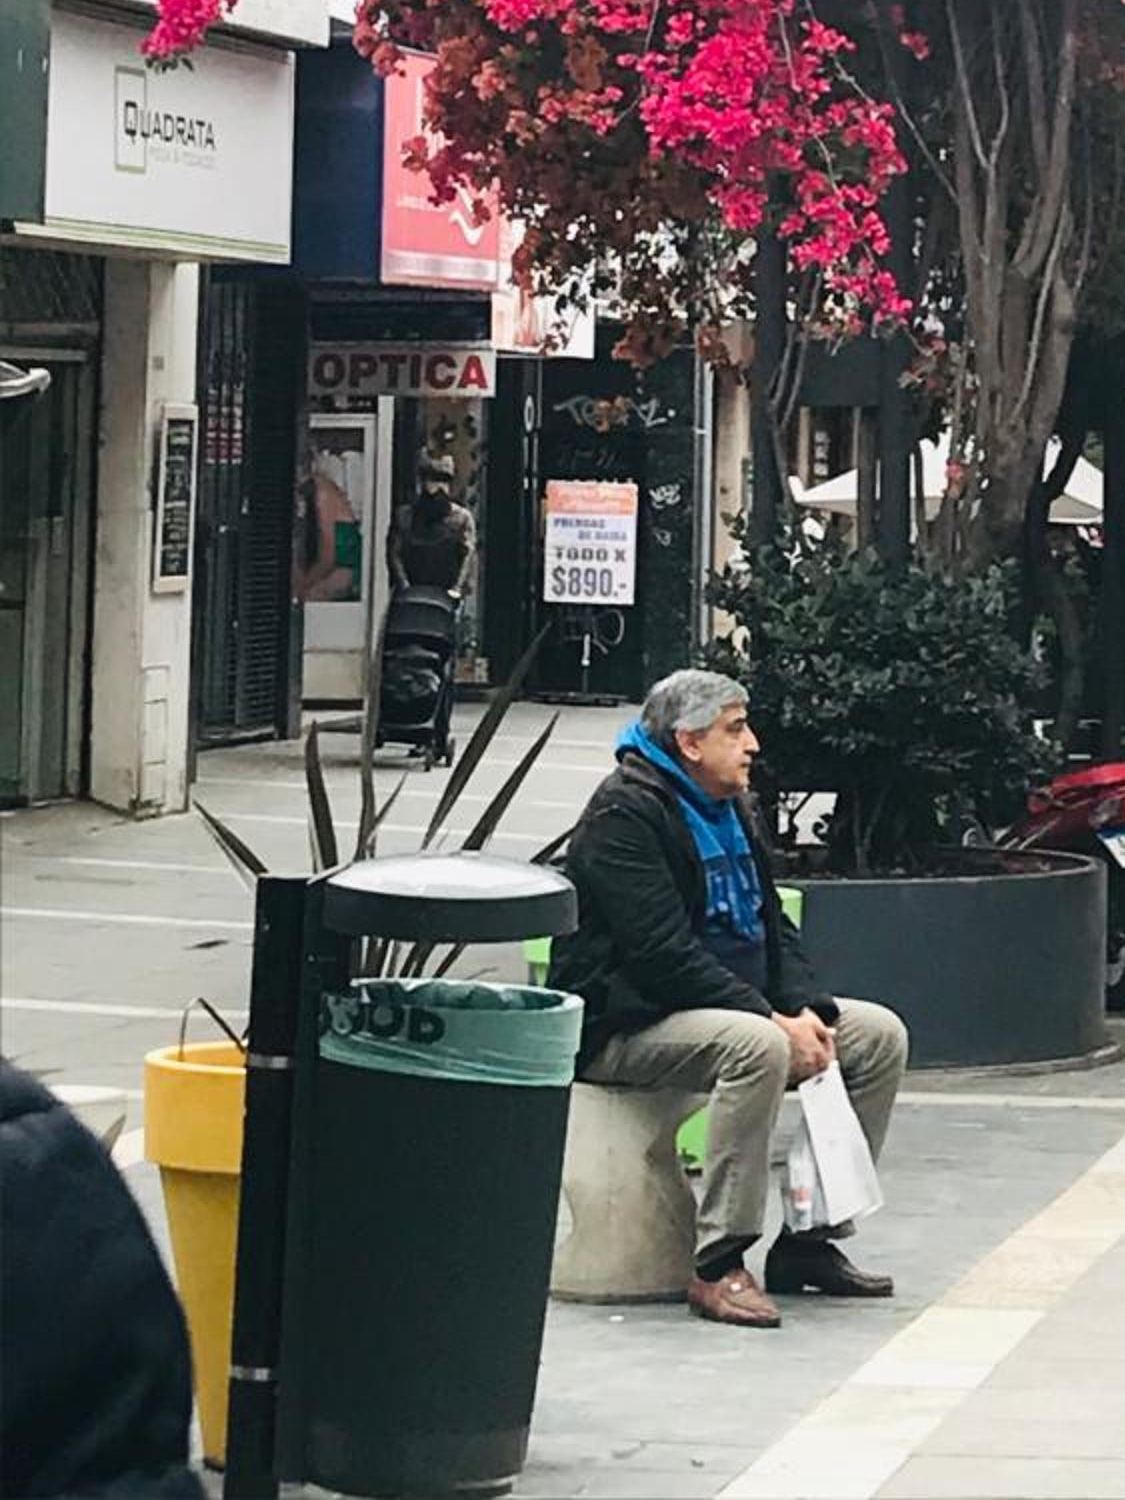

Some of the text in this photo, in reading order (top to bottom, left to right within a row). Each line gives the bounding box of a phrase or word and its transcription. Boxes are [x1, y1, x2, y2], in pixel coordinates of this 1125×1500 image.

[123, 100, 217, 150] QUADRATA
[313, 353, 489, 390] OPTICA
[553, 546, 608, 561] TODO
